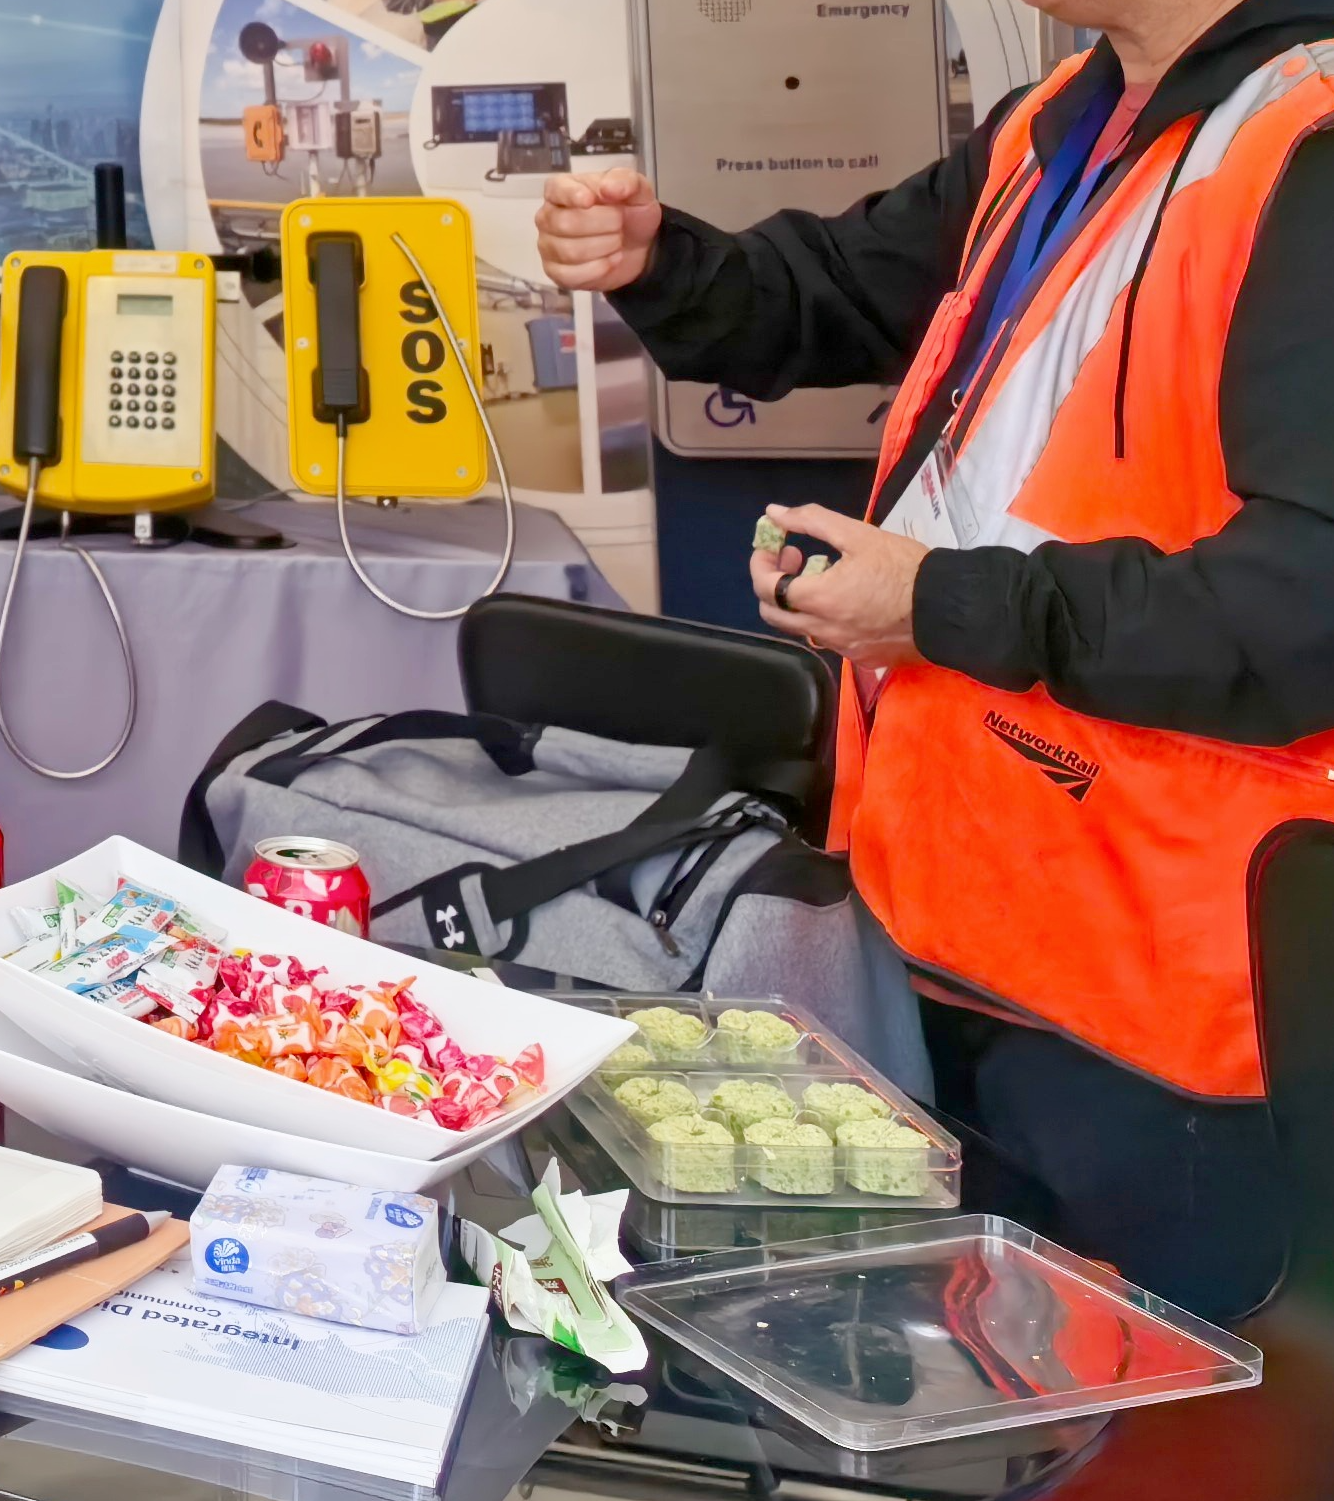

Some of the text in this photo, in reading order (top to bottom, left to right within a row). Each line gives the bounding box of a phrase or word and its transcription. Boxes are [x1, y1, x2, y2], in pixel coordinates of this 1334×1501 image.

[816, 2, 910, 19] Emergency
[716, 155, 879, 172] Press button to call
[398, 279, 448, 425] SOS
[983, 709, 1100, 778] NetworkRail
[140, 1305, 300, 1351] Integrated
